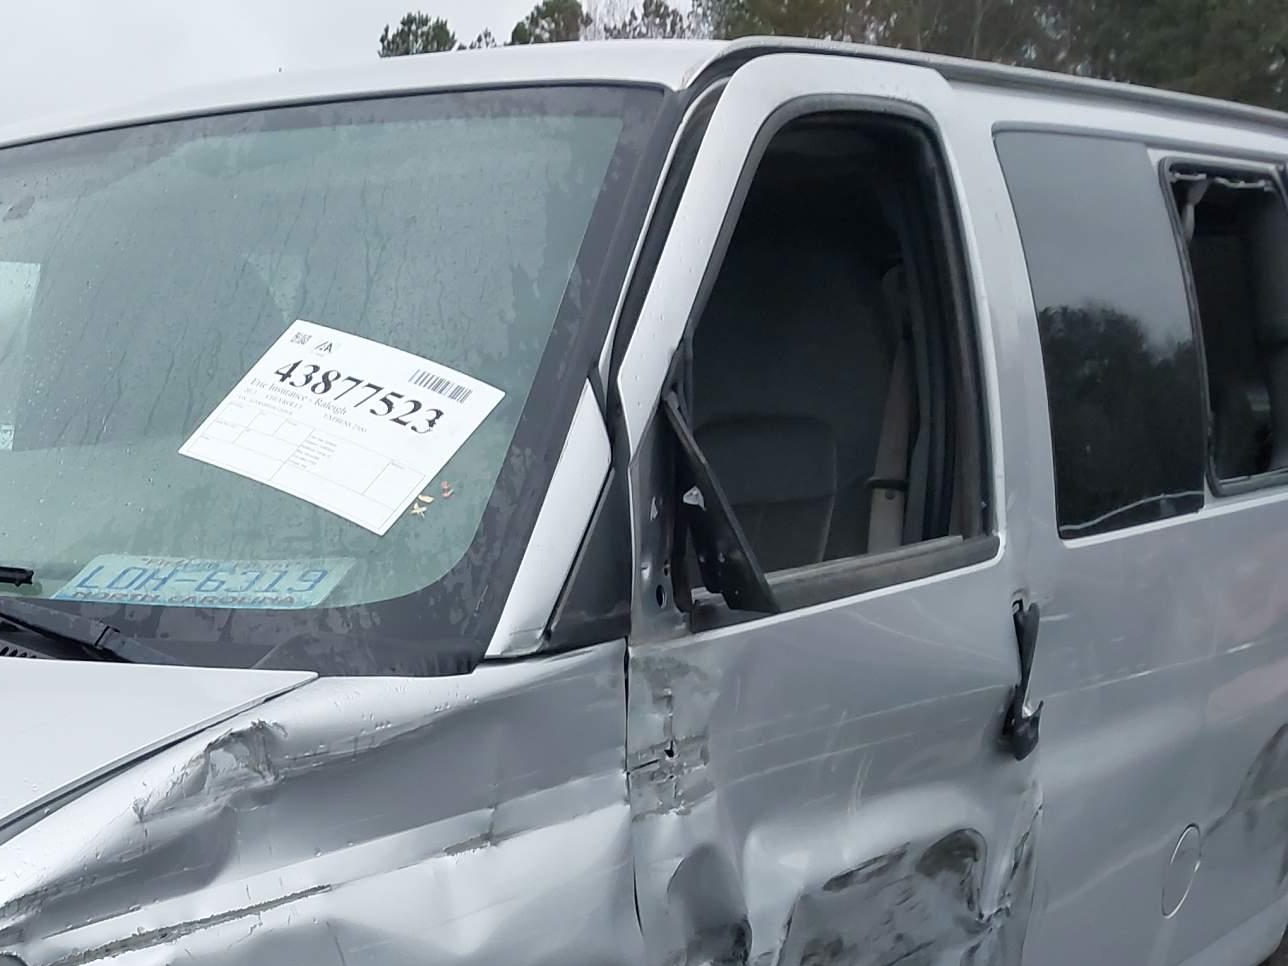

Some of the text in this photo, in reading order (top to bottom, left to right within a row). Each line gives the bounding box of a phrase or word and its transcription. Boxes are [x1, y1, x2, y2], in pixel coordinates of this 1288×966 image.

[268, 383, 307, 401] Insurance
[314, 397, 347, 416] Raleigh
[274, 359, 444, 434] 43877523
[72, 590, 296, 606] NORTH CAROLINA
